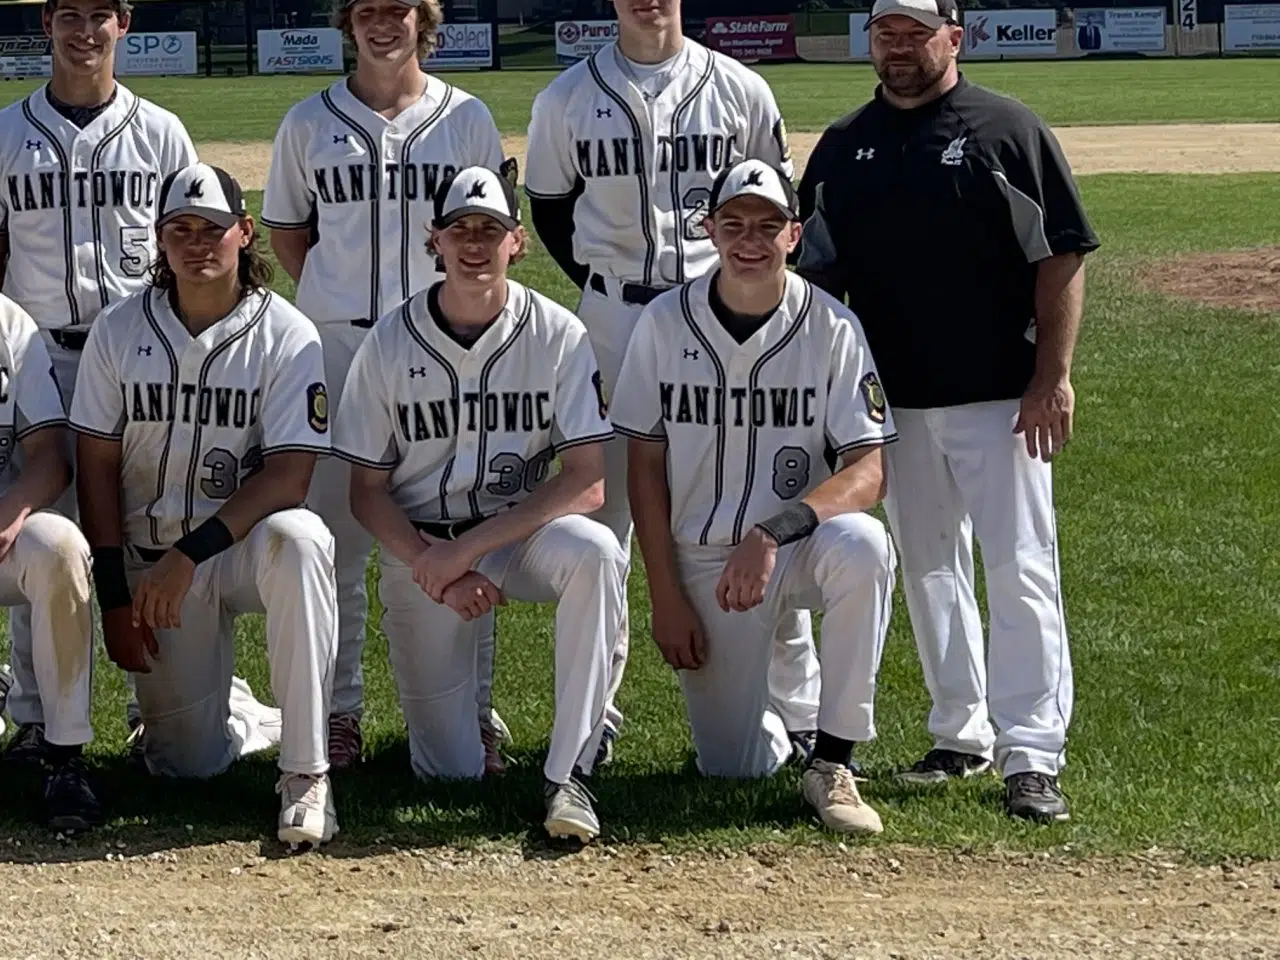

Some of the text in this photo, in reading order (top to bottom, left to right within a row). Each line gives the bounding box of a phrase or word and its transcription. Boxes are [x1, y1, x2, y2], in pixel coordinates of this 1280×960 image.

[282, 34, 319, 46] Mada
[435, 25, 490, 49] oSelect
[581, 22, 619, 38] PuroC
[996, 24, 1057, 41] Keller
[266, 55, 334, 66] FASTSIGNS
[578, 134, 738, 178] MANITOWOC
[7, 170, 157, 212] MANITOWOC
[314, 163, 458, 204] MANITOW
[120, 226, 150, 278] 5
[122, 382, 262, 429] ANITOWOC
[658, 381, 816, 428] MANITOWOC
[772, 445, 811, 501] 8
